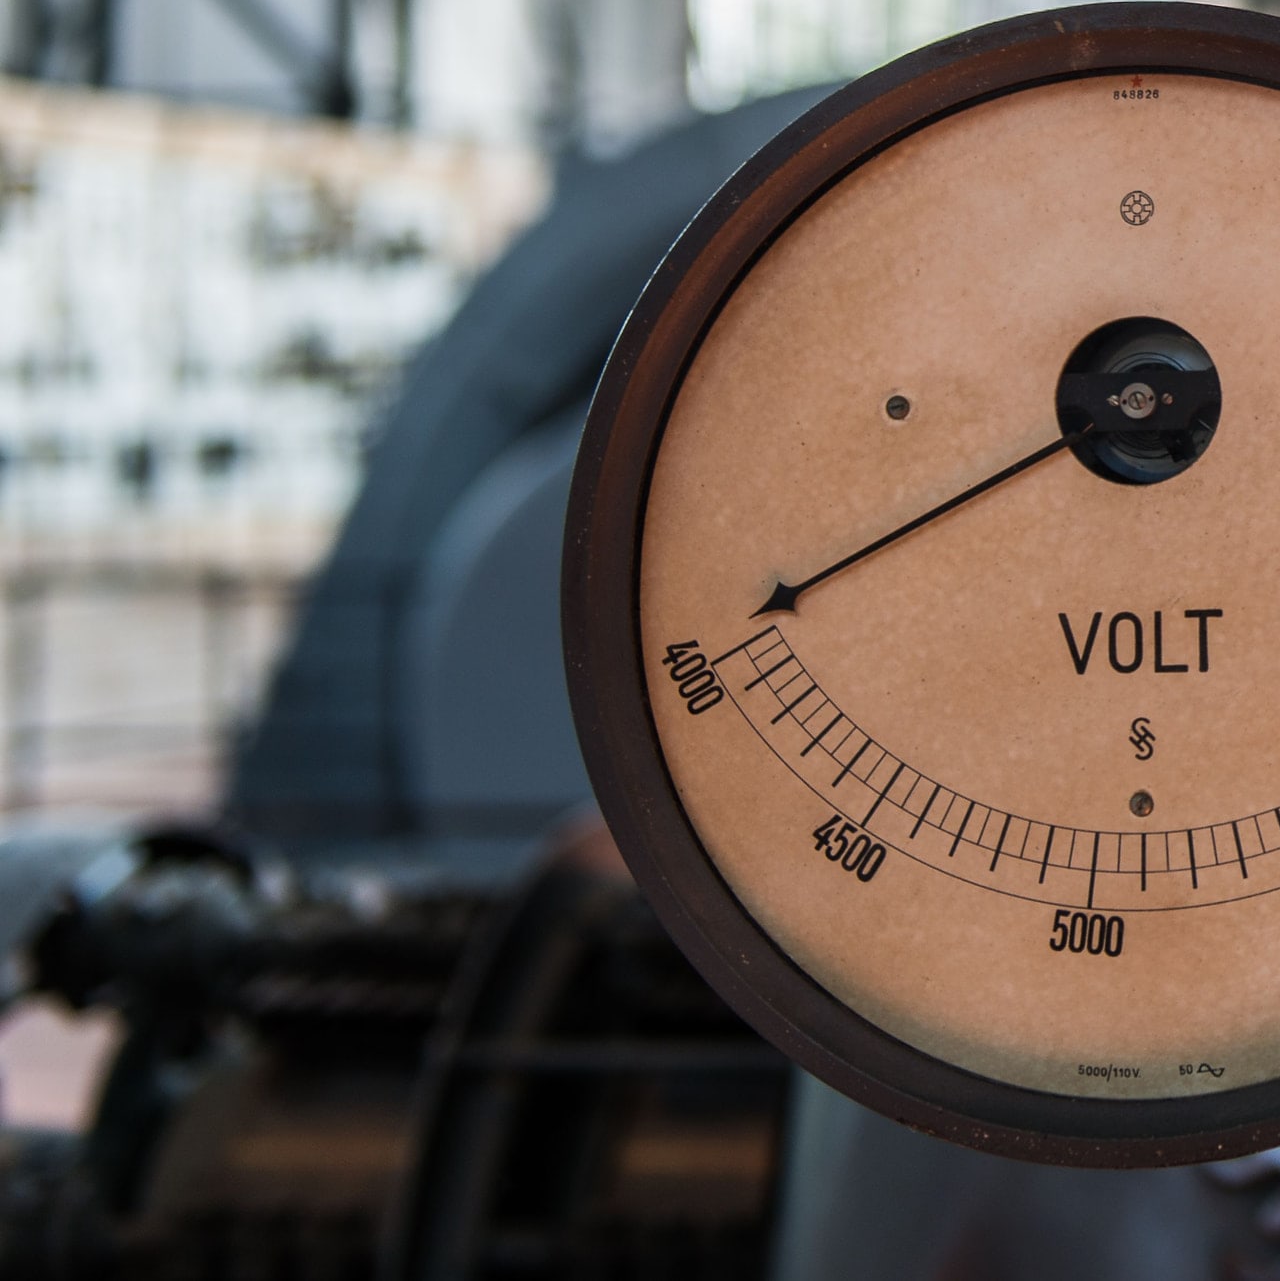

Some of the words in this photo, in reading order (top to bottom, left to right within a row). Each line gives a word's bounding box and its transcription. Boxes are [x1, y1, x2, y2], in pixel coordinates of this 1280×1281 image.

[1058, 609, 1223, 675] VOLT
[661, 639, 724, 716] 4000
[812, 814, 887, 883] 4500
[1049, 910, 1125, 958] 5000
[1179, 1064, 1193, 1075] 50
